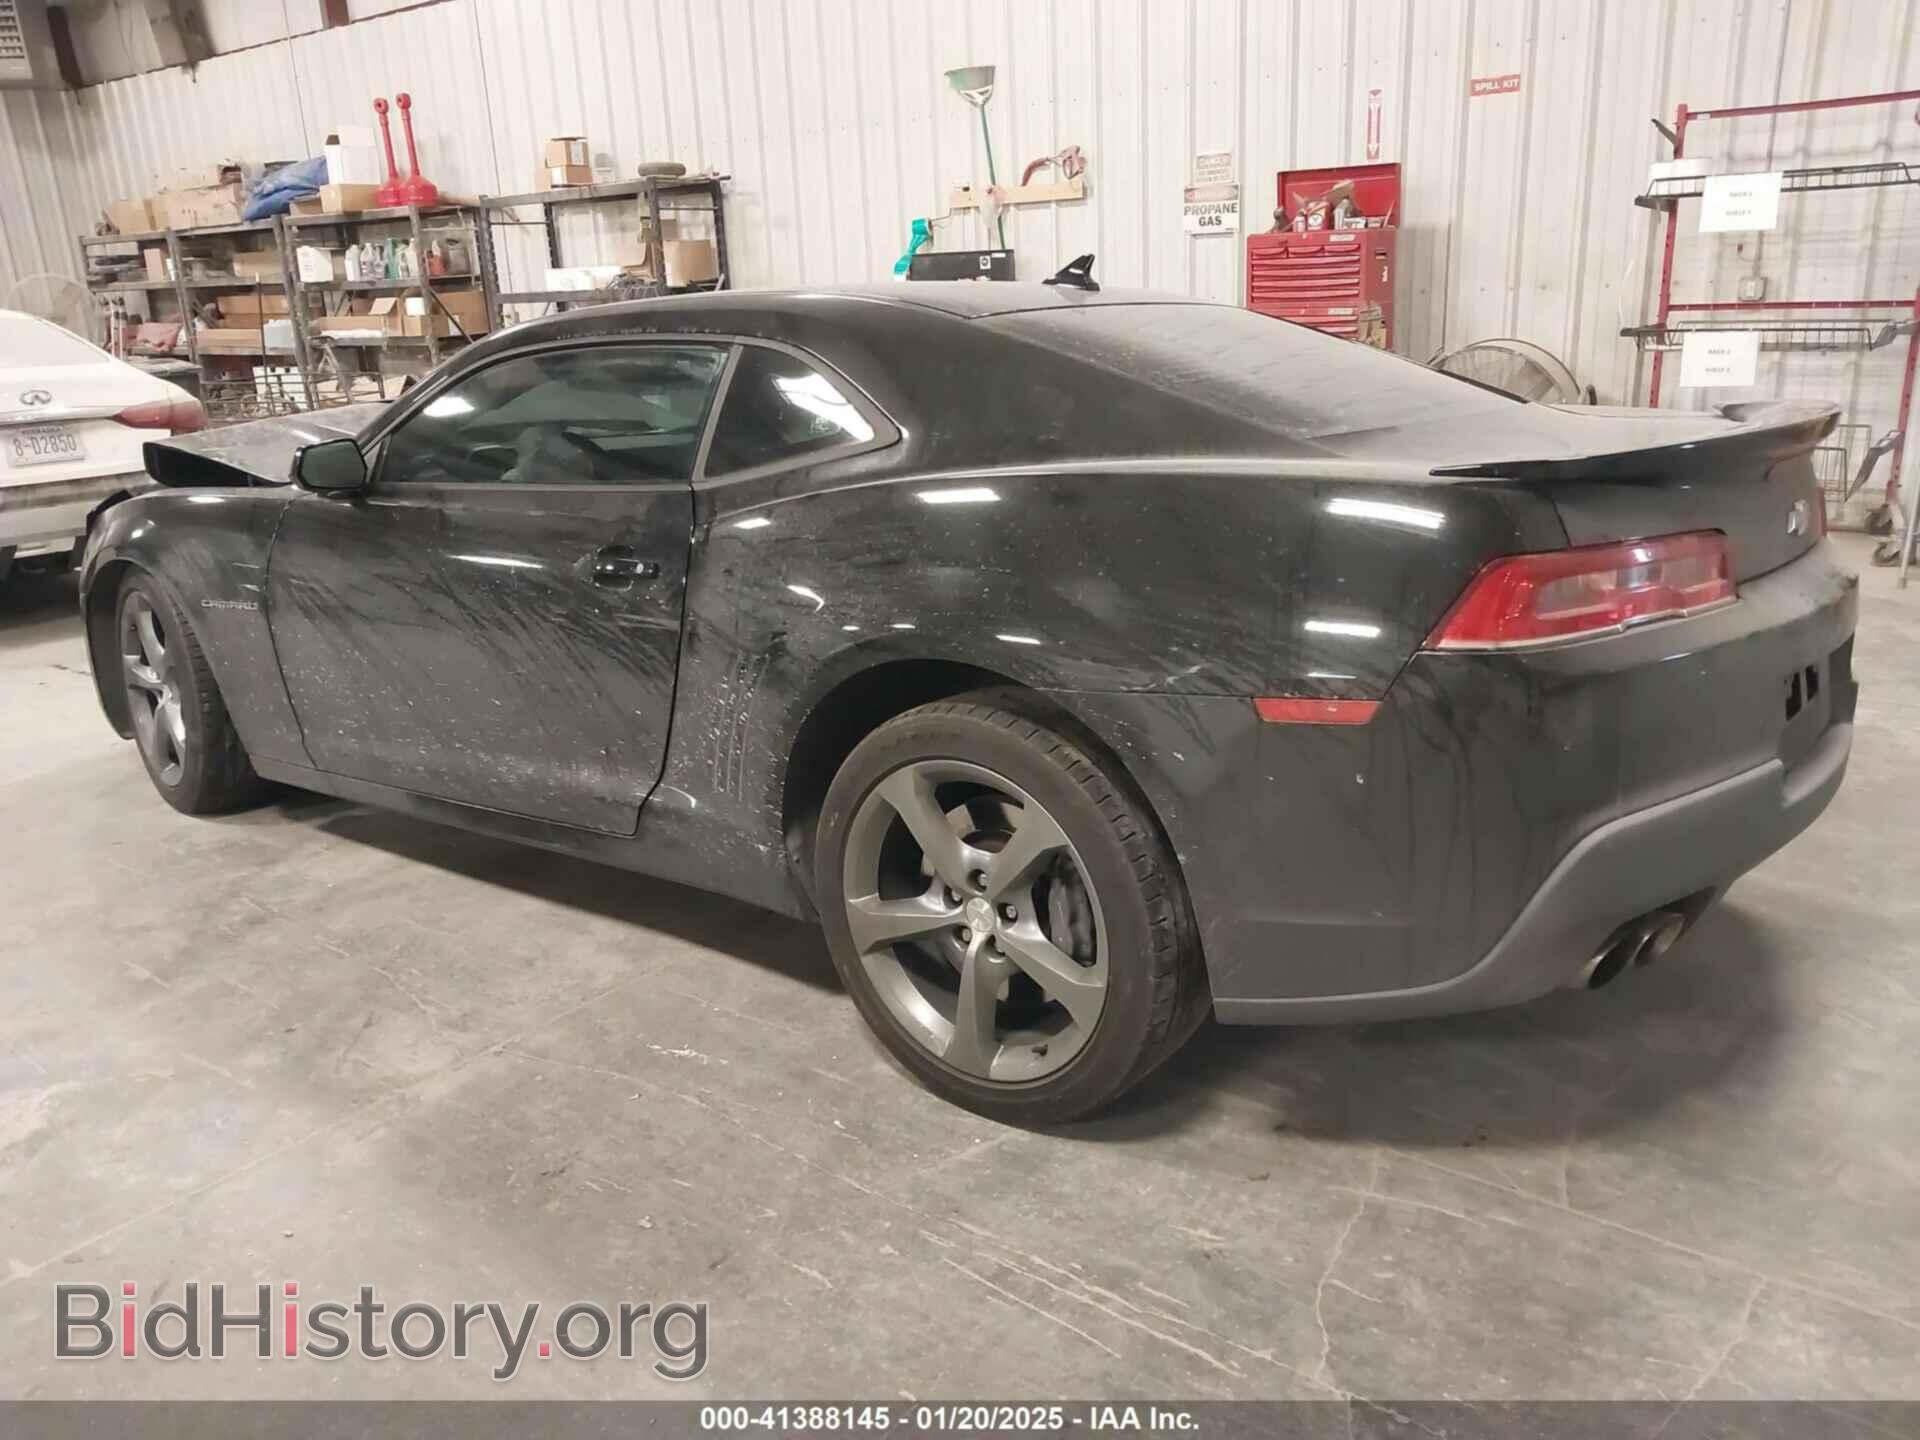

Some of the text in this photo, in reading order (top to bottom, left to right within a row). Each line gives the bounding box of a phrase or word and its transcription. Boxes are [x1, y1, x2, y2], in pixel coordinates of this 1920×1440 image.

[1475, 79, 1519, 91] SPILL KIT
[1183, 202, 1239, 216] PROPANE
[1198, 215, 1222, 227] GAS
